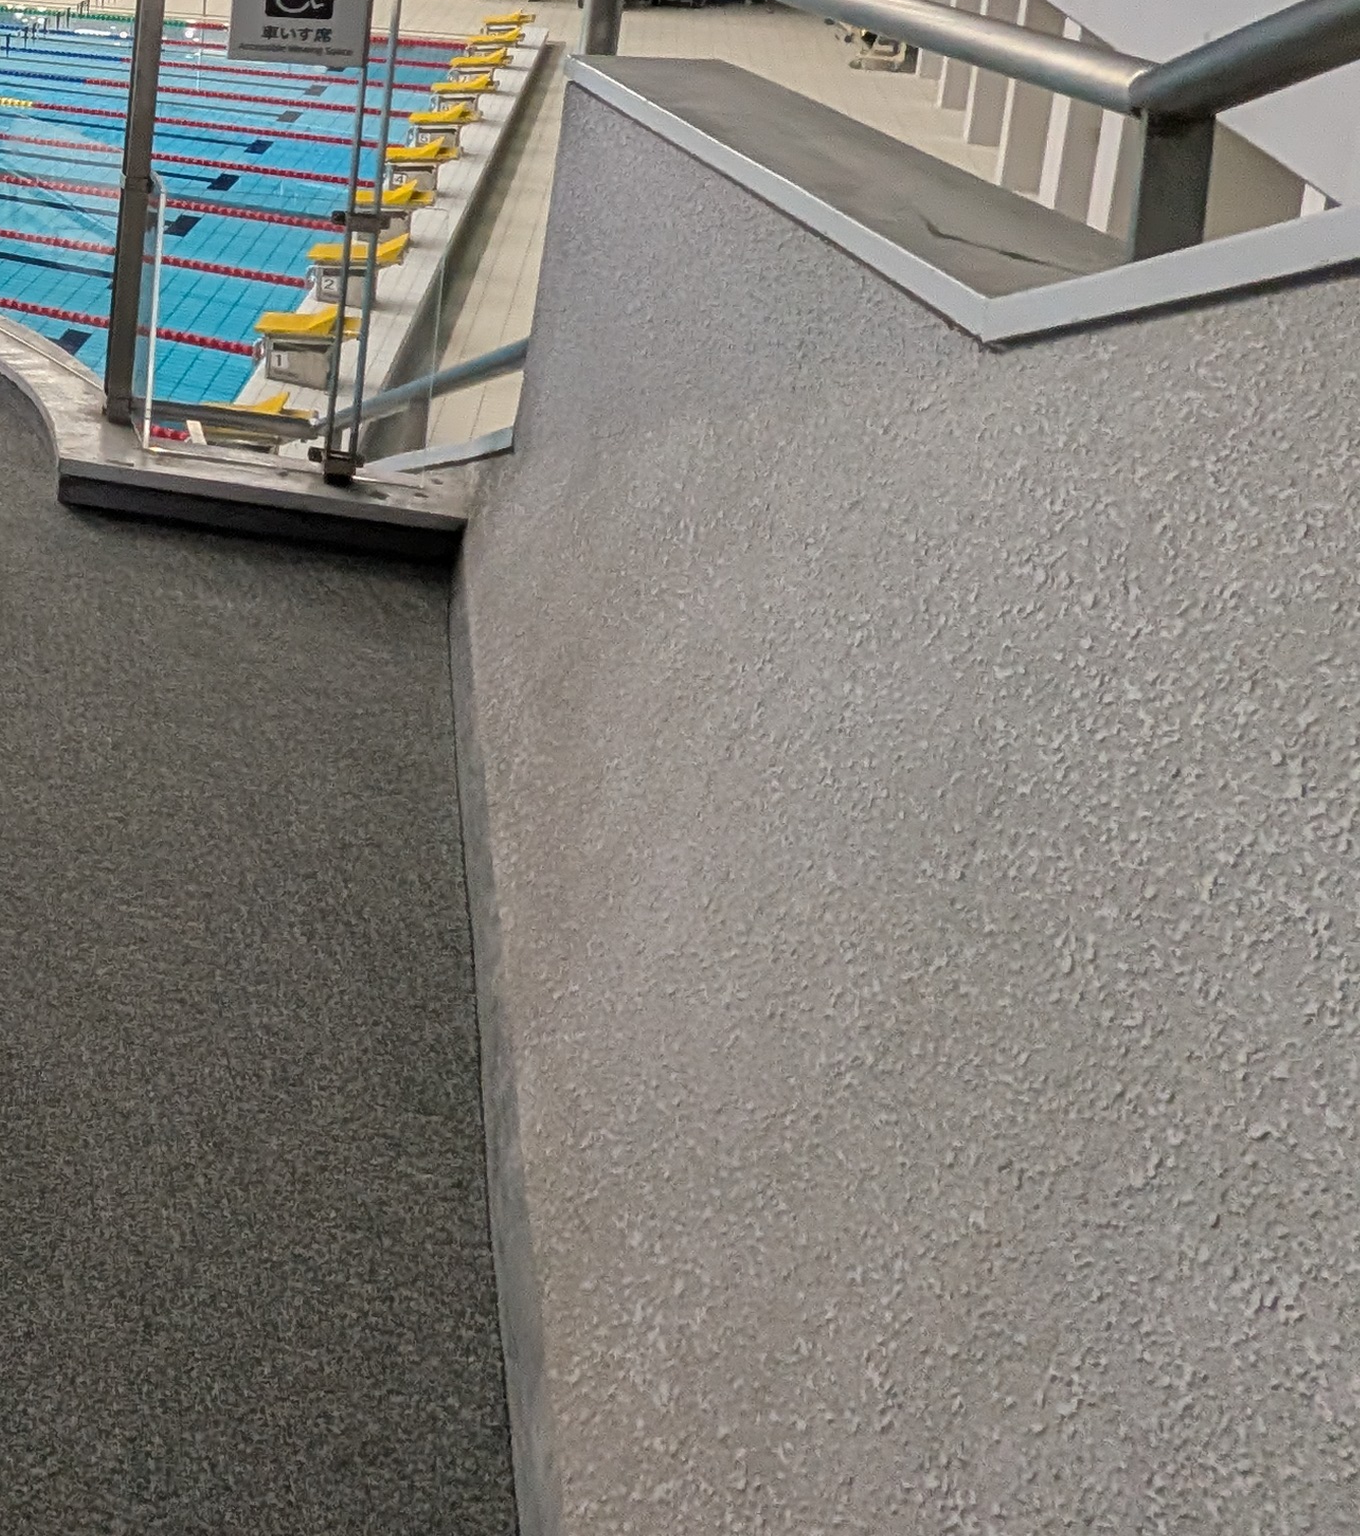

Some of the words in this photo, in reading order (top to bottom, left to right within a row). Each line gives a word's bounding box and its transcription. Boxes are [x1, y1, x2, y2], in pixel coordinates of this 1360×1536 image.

[261, 25, 332, 42] 車いす席
[323, 278, 335, 290] 2
[275, 354, 282, 367] 1
